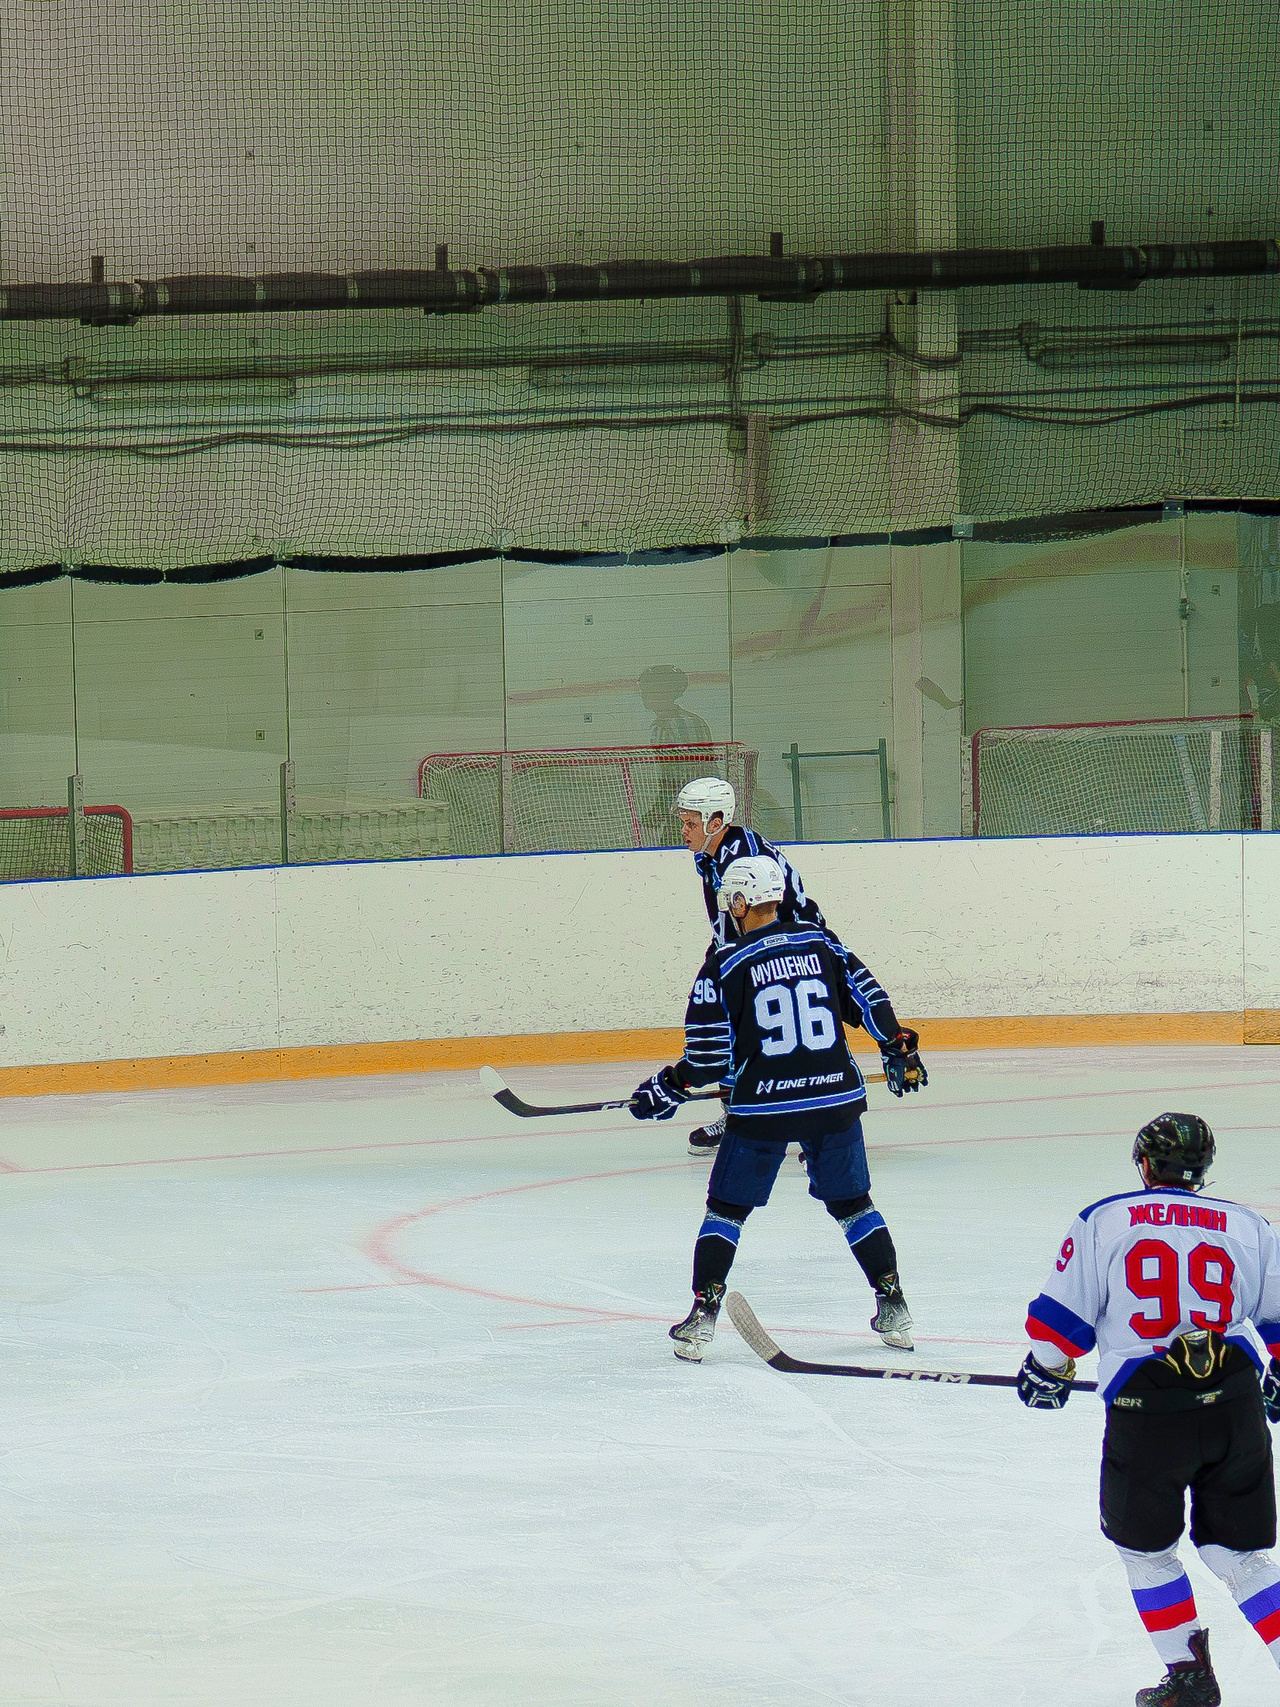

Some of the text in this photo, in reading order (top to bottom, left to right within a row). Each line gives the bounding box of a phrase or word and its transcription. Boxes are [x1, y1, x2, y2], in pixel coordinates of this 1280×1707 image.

[750, 953, 822, 987] МУЩЕНКО
[693, 978, 717, 1005] 96
[754, 979, 837, 1056] 96
[776, 1071, 845, 1090] ONE TIMER
[1127, 1203, 1227, 1233] ЖЕЛНИН
[1125, 1239, 1235, 1339] 99
[882, 1370, 972, 1385] CCM
